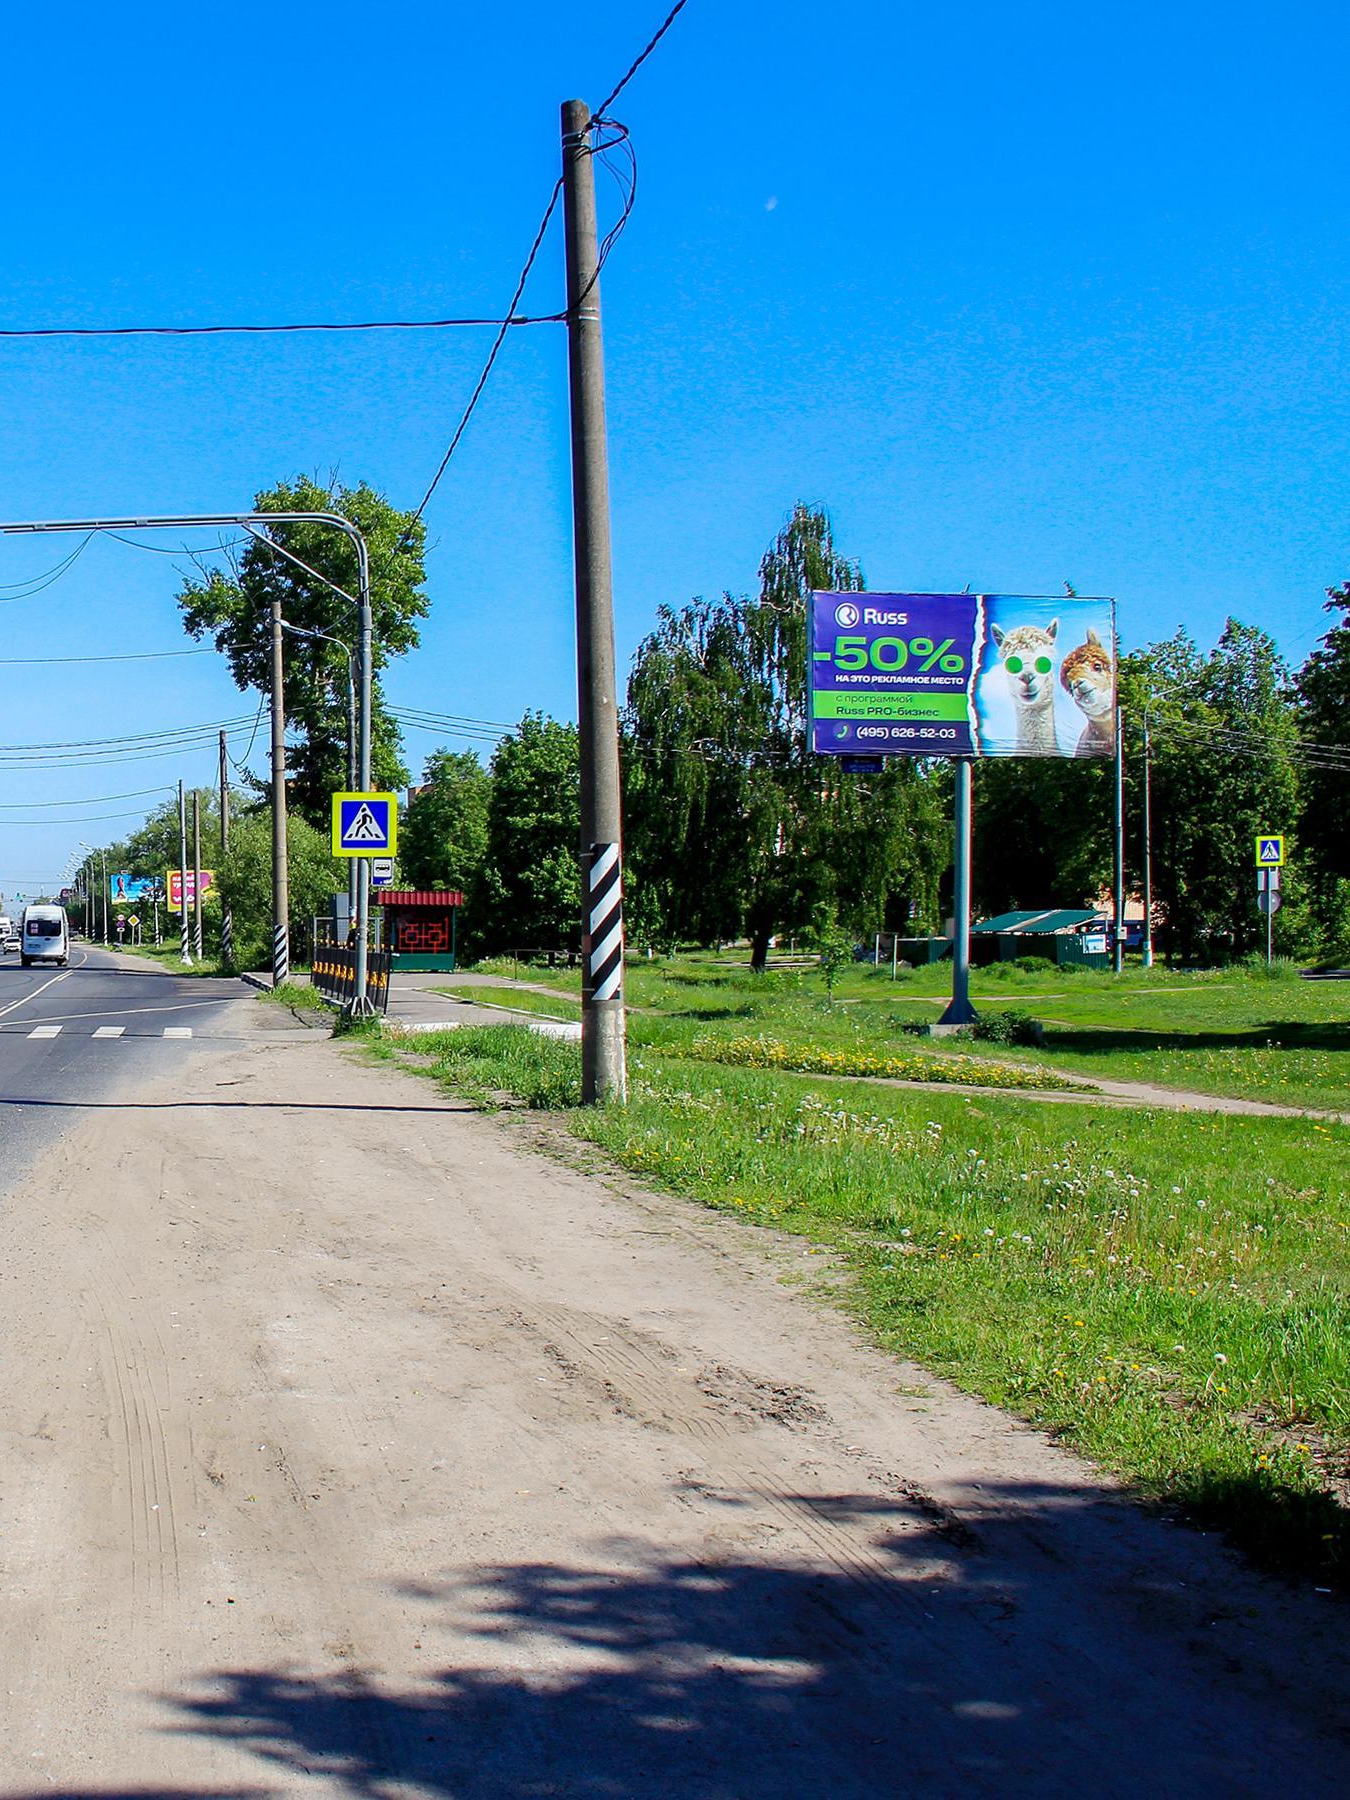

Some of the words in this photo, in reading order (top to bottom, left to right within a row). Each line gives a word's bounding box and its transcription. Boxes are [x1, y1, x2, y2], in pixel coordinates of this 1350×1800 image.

[863, 608, 908, 625] Russ
[813, 636, 965, 673] -50%
[835, 674, 849, 683] НА
[850, 674, 871, 684] ЭТО
[871, 675, 930, 685] РЕКЛАМНОЕ
[930, 676, 964, 685] МЕСТО
[835, 695, 843, 703] с
[844, 694, 913, 704] программой
[836, 706, 865, 715] Russ
[867, 706, 939, 717] PRO-бизнес
[856, 727, 889, 739] (495)
[891, 727, 956, 739] 626-52-03
